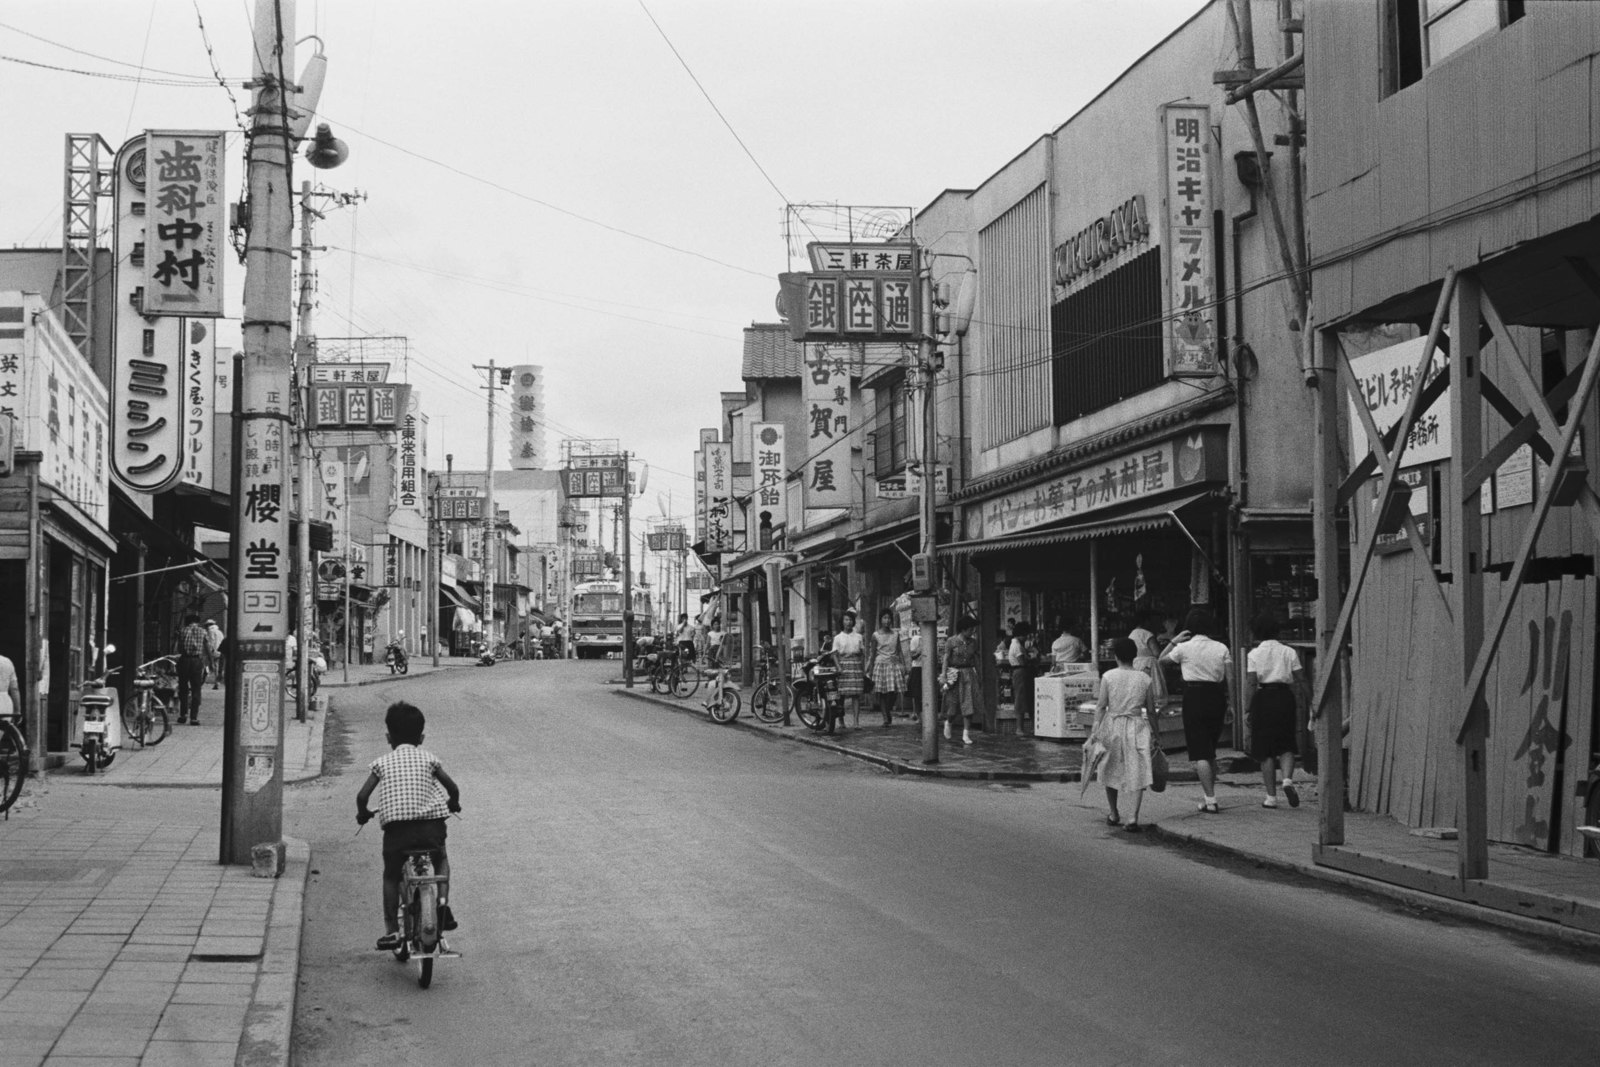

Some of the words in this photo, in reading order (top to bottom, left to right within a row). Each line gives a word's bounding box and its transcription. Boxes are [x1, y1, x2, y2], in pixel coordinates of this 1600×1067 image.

[1054, 194, 1147, 286] KIMURAYA
[1175, 118, 1204, 309] 明治キャラメル
[828, 252, 913, 270] 三軒茶屋
[809, 281, 909, 329] 銀座通
[316, 369, 380, 382] 三軒茶屋
[320, 389, 394, 423] 銀座通
[808, 351, 836, 492] 古賀屋
[245, 407, 260, 478] しい眼鏡
[400, 413, 417, 505] 全東栄信用組合
[325, 483, 338, 520] ヤマハ
[758, 450, 782, 507] 御所飴
[245, 483, 280, 579] 櫻堂
[248, 595, 276, 608] ココ
